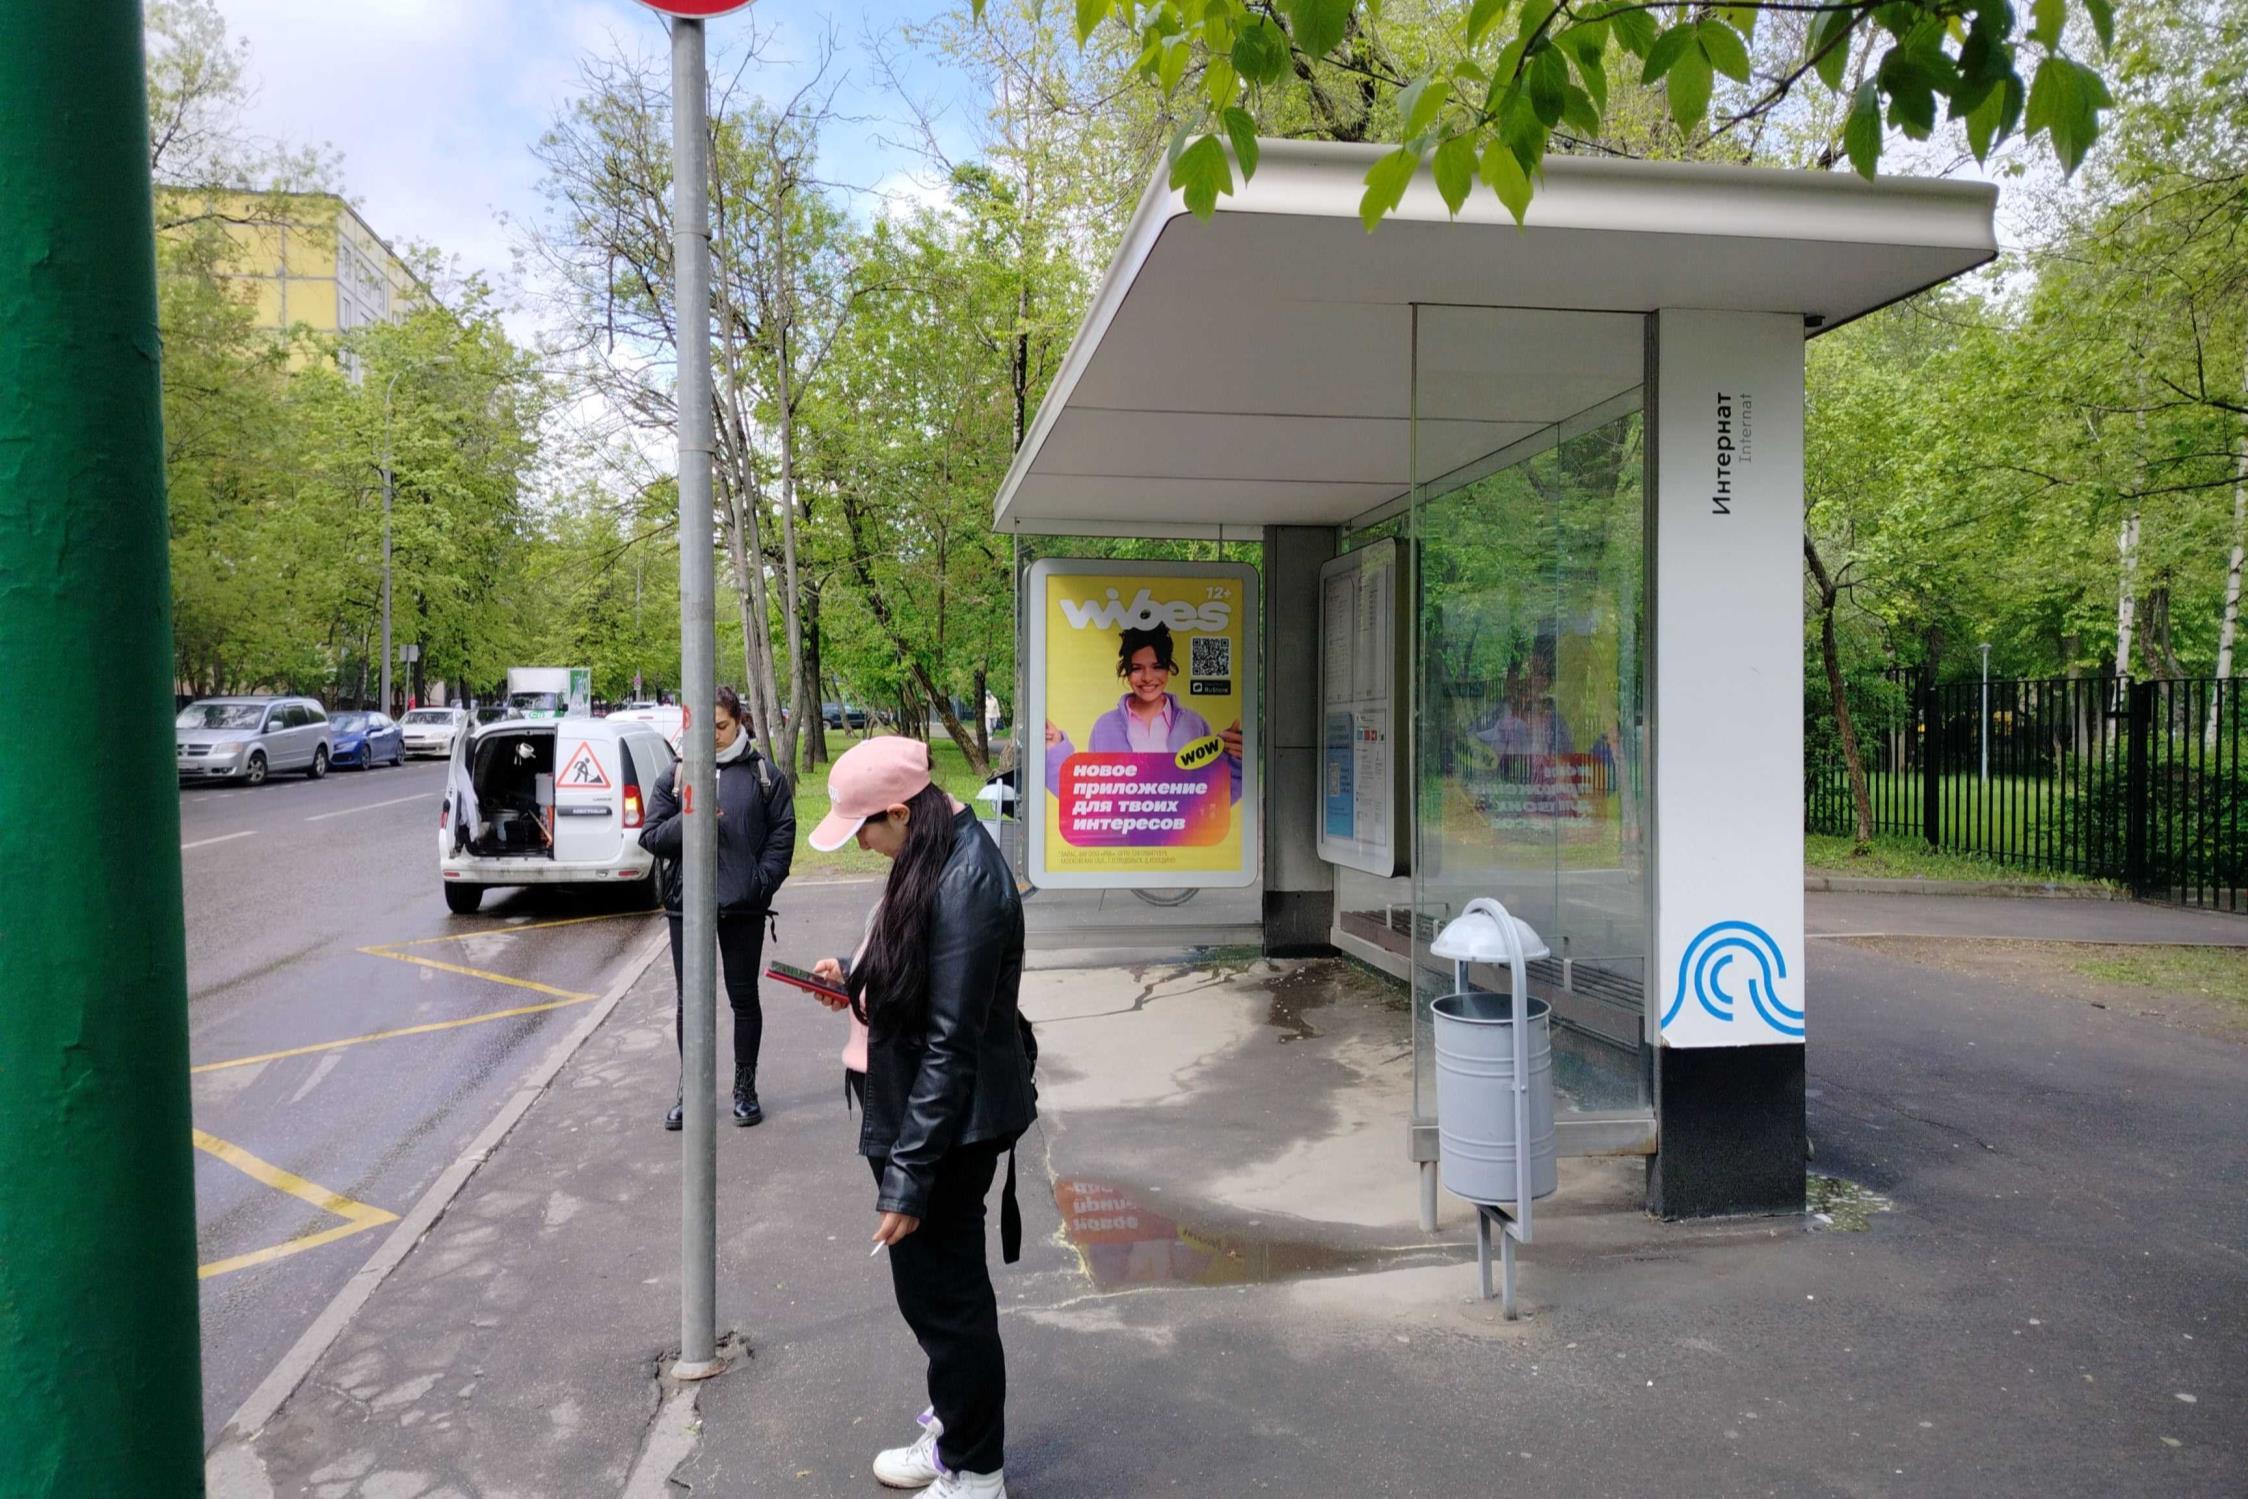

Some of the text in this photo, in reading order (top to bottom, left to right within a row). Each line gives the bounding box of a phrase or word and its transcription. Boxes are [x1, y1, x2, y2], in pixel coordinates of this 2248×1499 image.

[1739, 393, 1752, 463] Internat
[1712, 392, 1735, 514] Интернат
[1207, 587, 1232, 599] 12+
[1073, 765, 1137, 777] новое
[1073, 783, 1208, 799] приложение
[1072, 801, 1178, 815] для твоих
[1073, 818, 1186, 834] интересов
